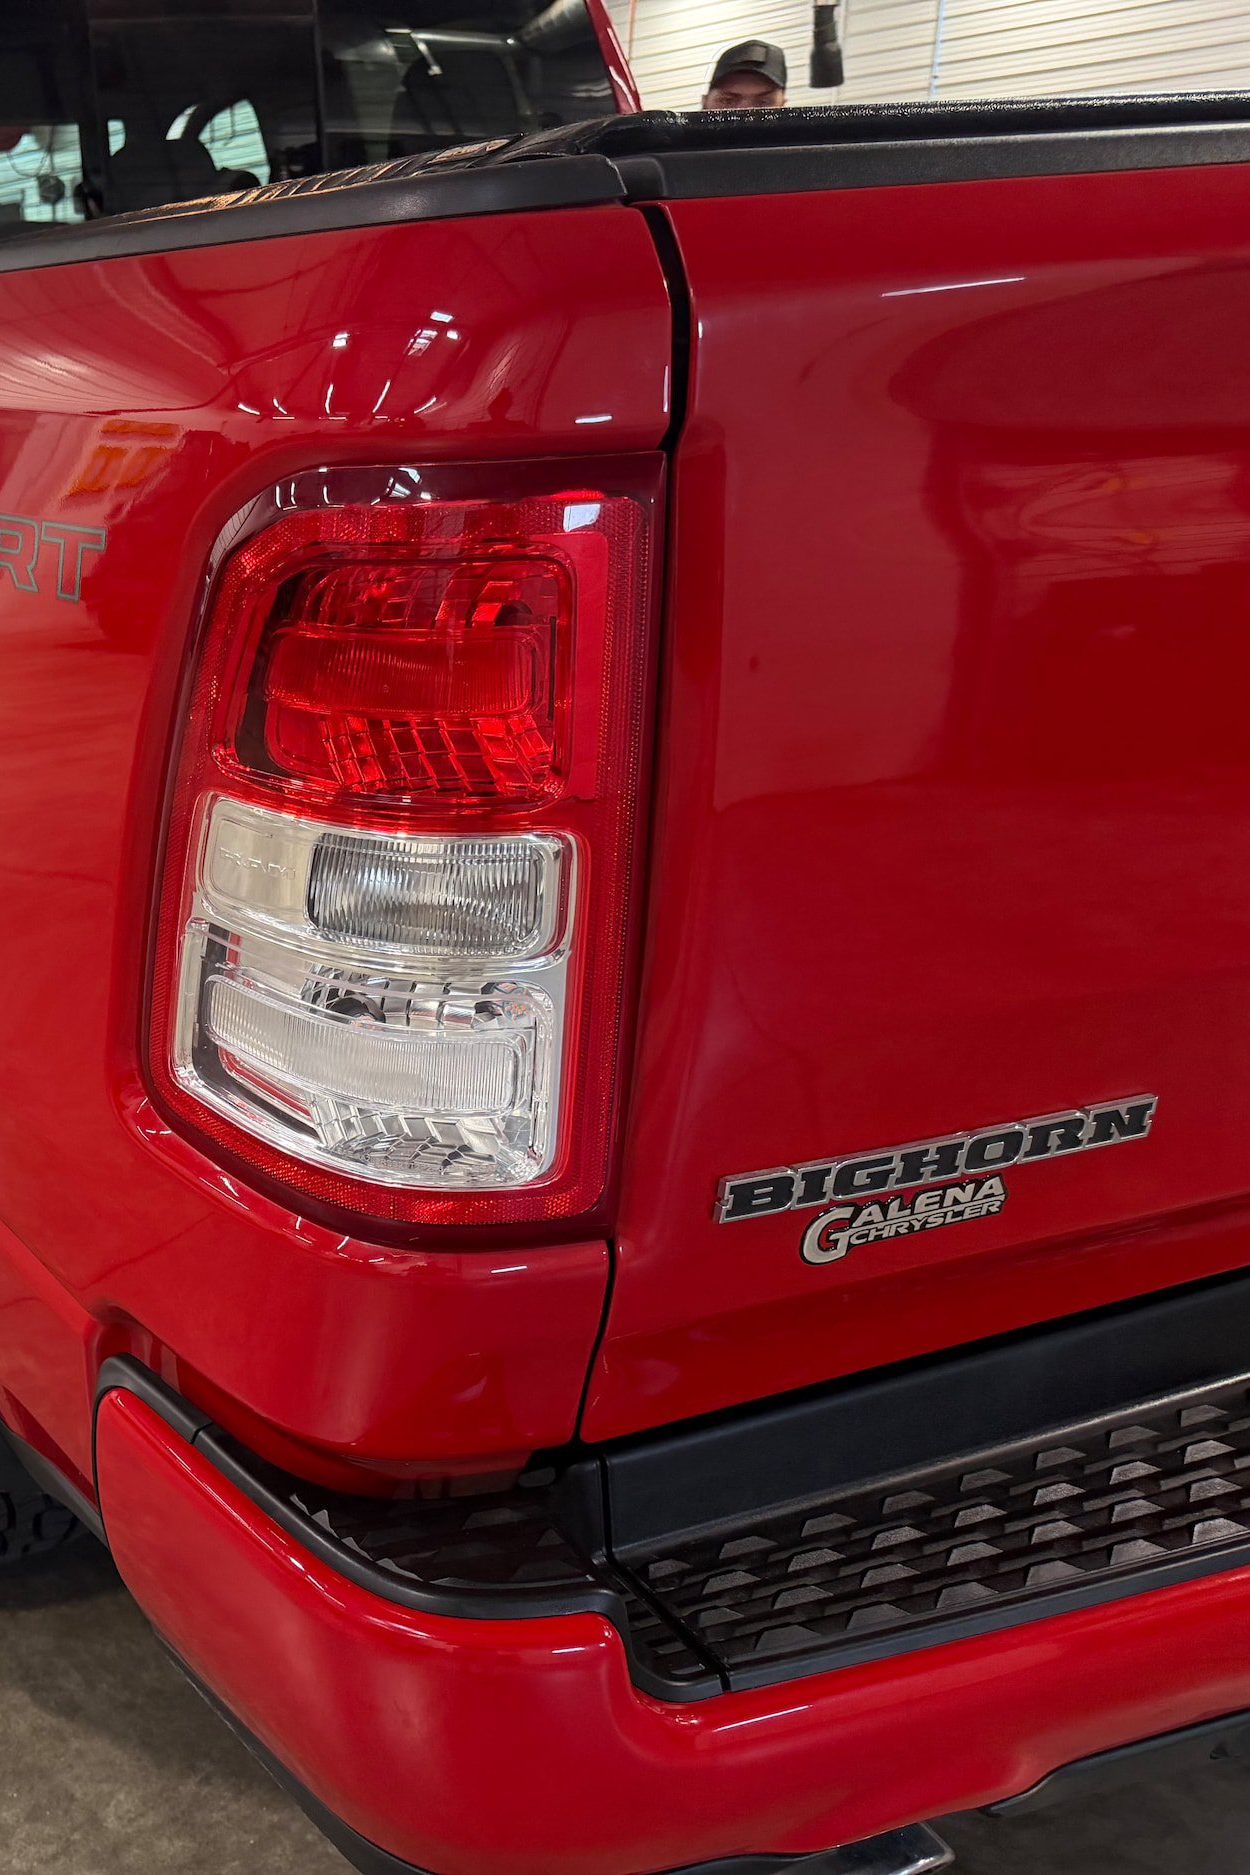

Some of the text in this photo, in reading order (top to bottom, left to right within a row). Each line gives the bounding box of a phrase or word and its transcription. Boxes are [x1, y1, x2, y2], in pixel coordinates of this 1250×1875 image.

[714, 1093, 1158, 1224] BIGHORN
[803, 1176, 1006, 1264] GALENA
[849, 1199, 1001, 1245] CHRYSLER
